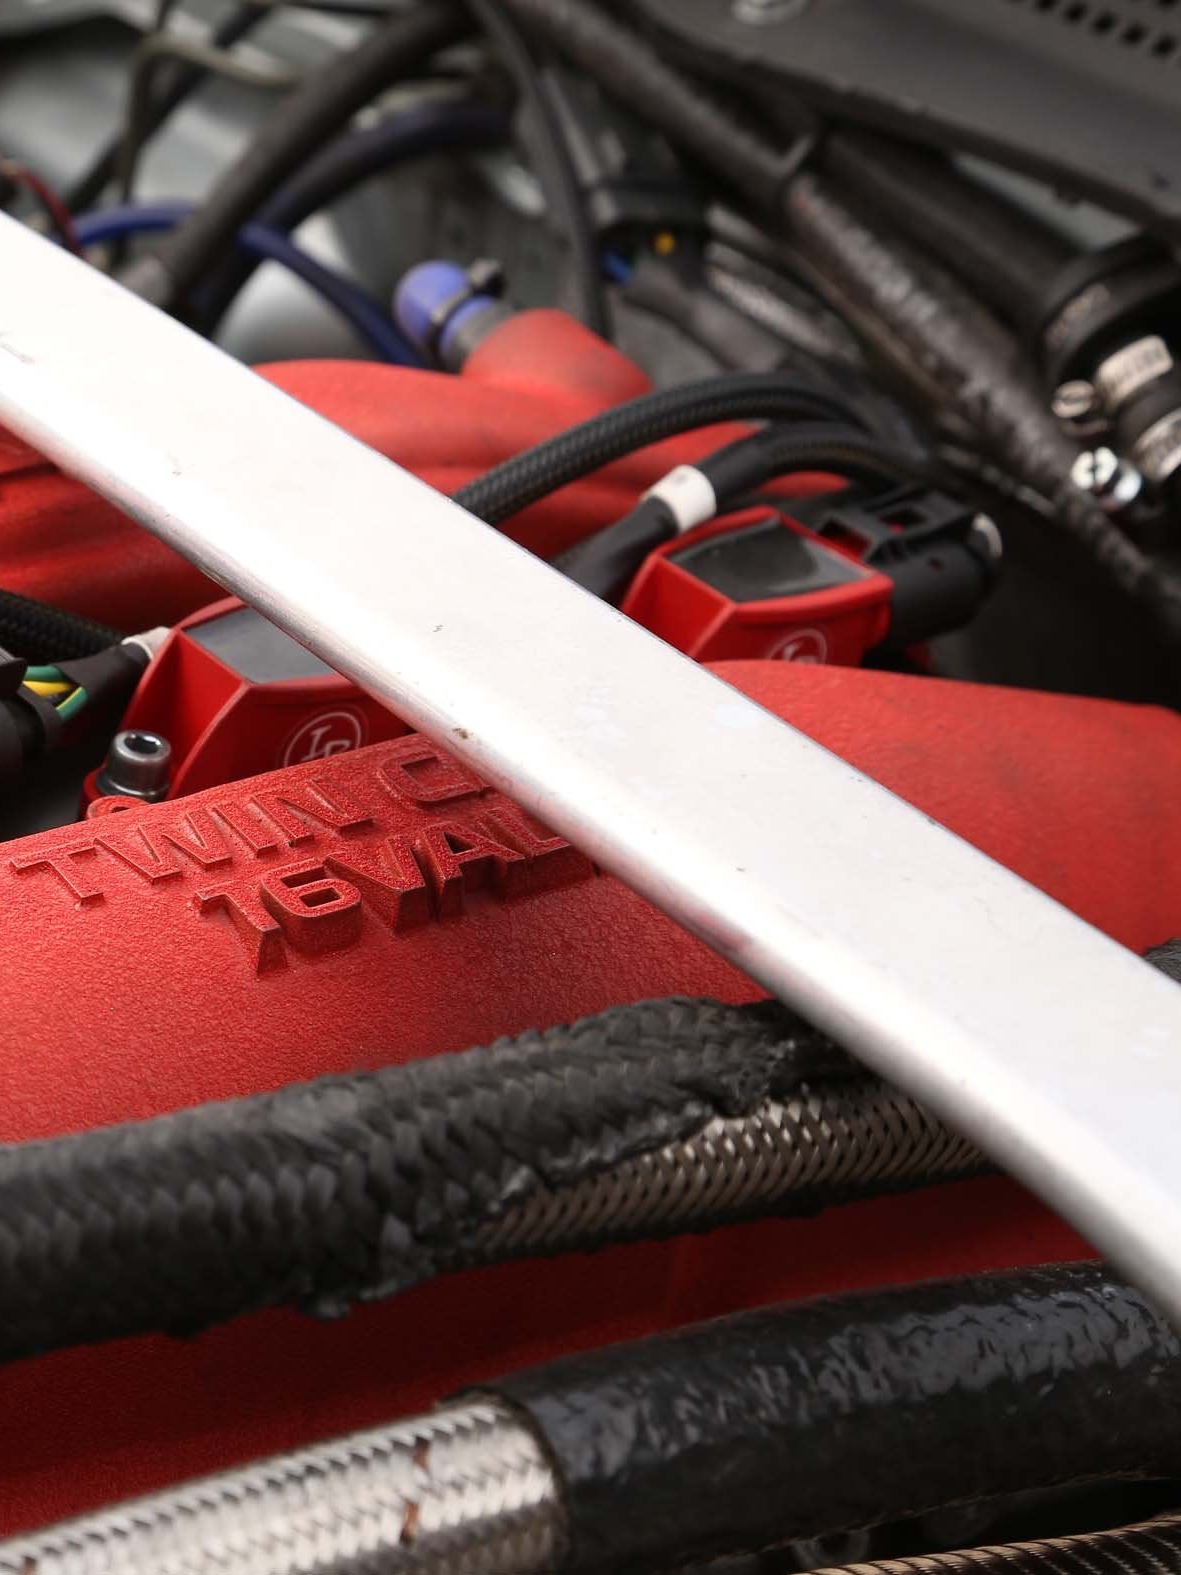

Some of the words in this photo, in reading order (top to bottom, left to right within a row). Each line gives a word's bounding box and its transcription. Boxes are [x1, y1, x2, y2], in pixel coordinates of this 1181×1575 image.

[10, 780, 373, 906] TWIN
[375, 742, 493, 803] C
[195, 806, 579, 970] 16VAL
